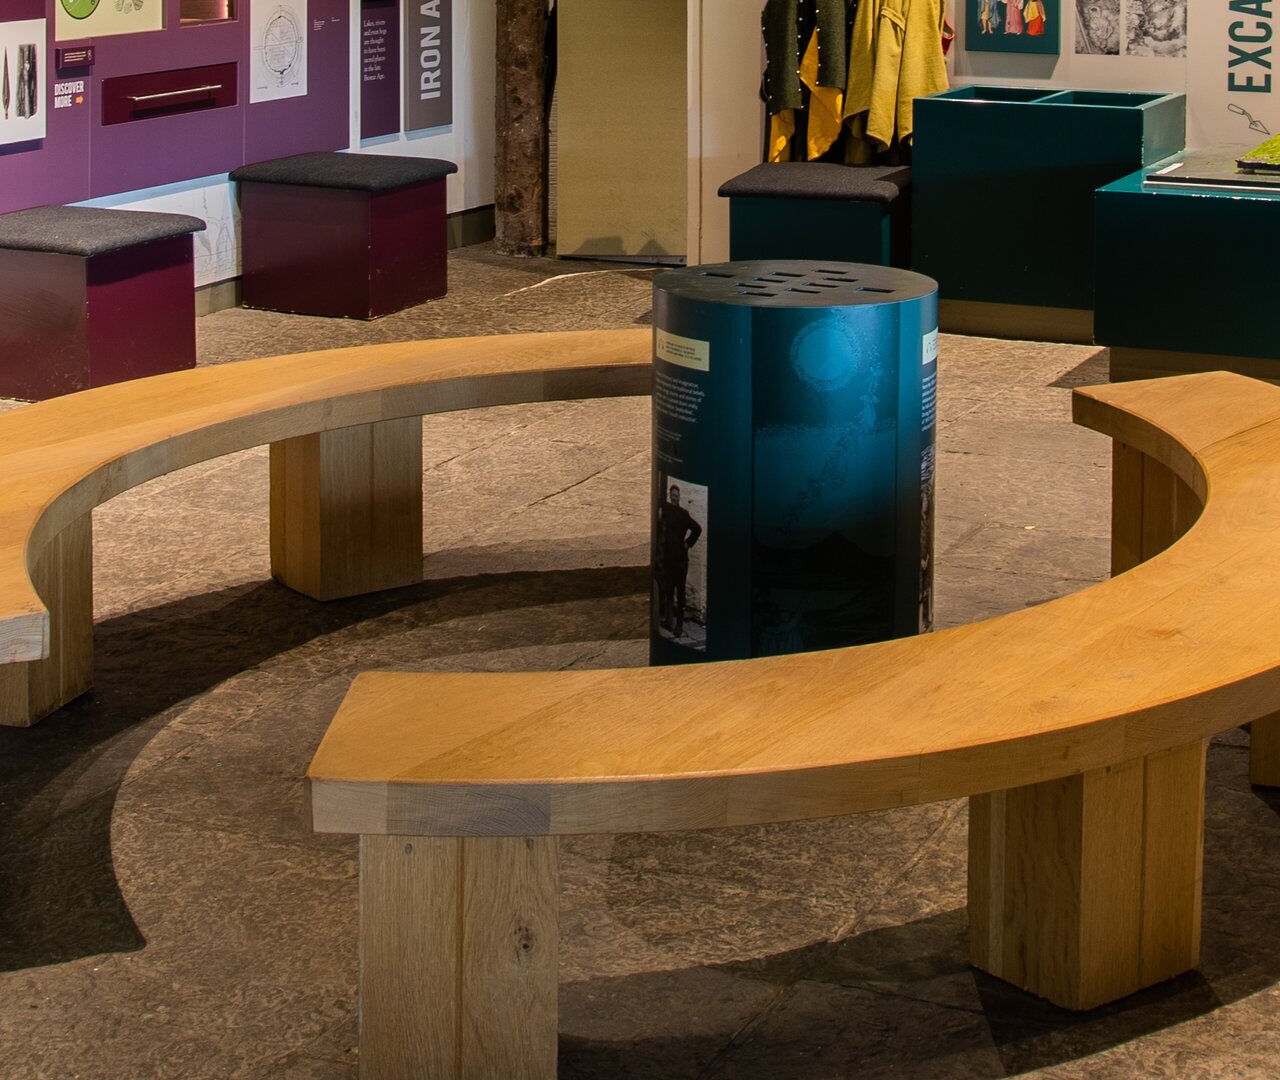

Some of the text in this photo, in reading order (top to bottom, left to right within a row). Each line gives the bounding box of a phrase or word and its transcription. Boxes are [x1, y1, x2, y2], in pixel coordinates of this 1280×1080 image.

[420, 26, 440, 100] IRON
[55, 81, 84, 95] DISCOVER
[55, 95, 72, 108] MORE
